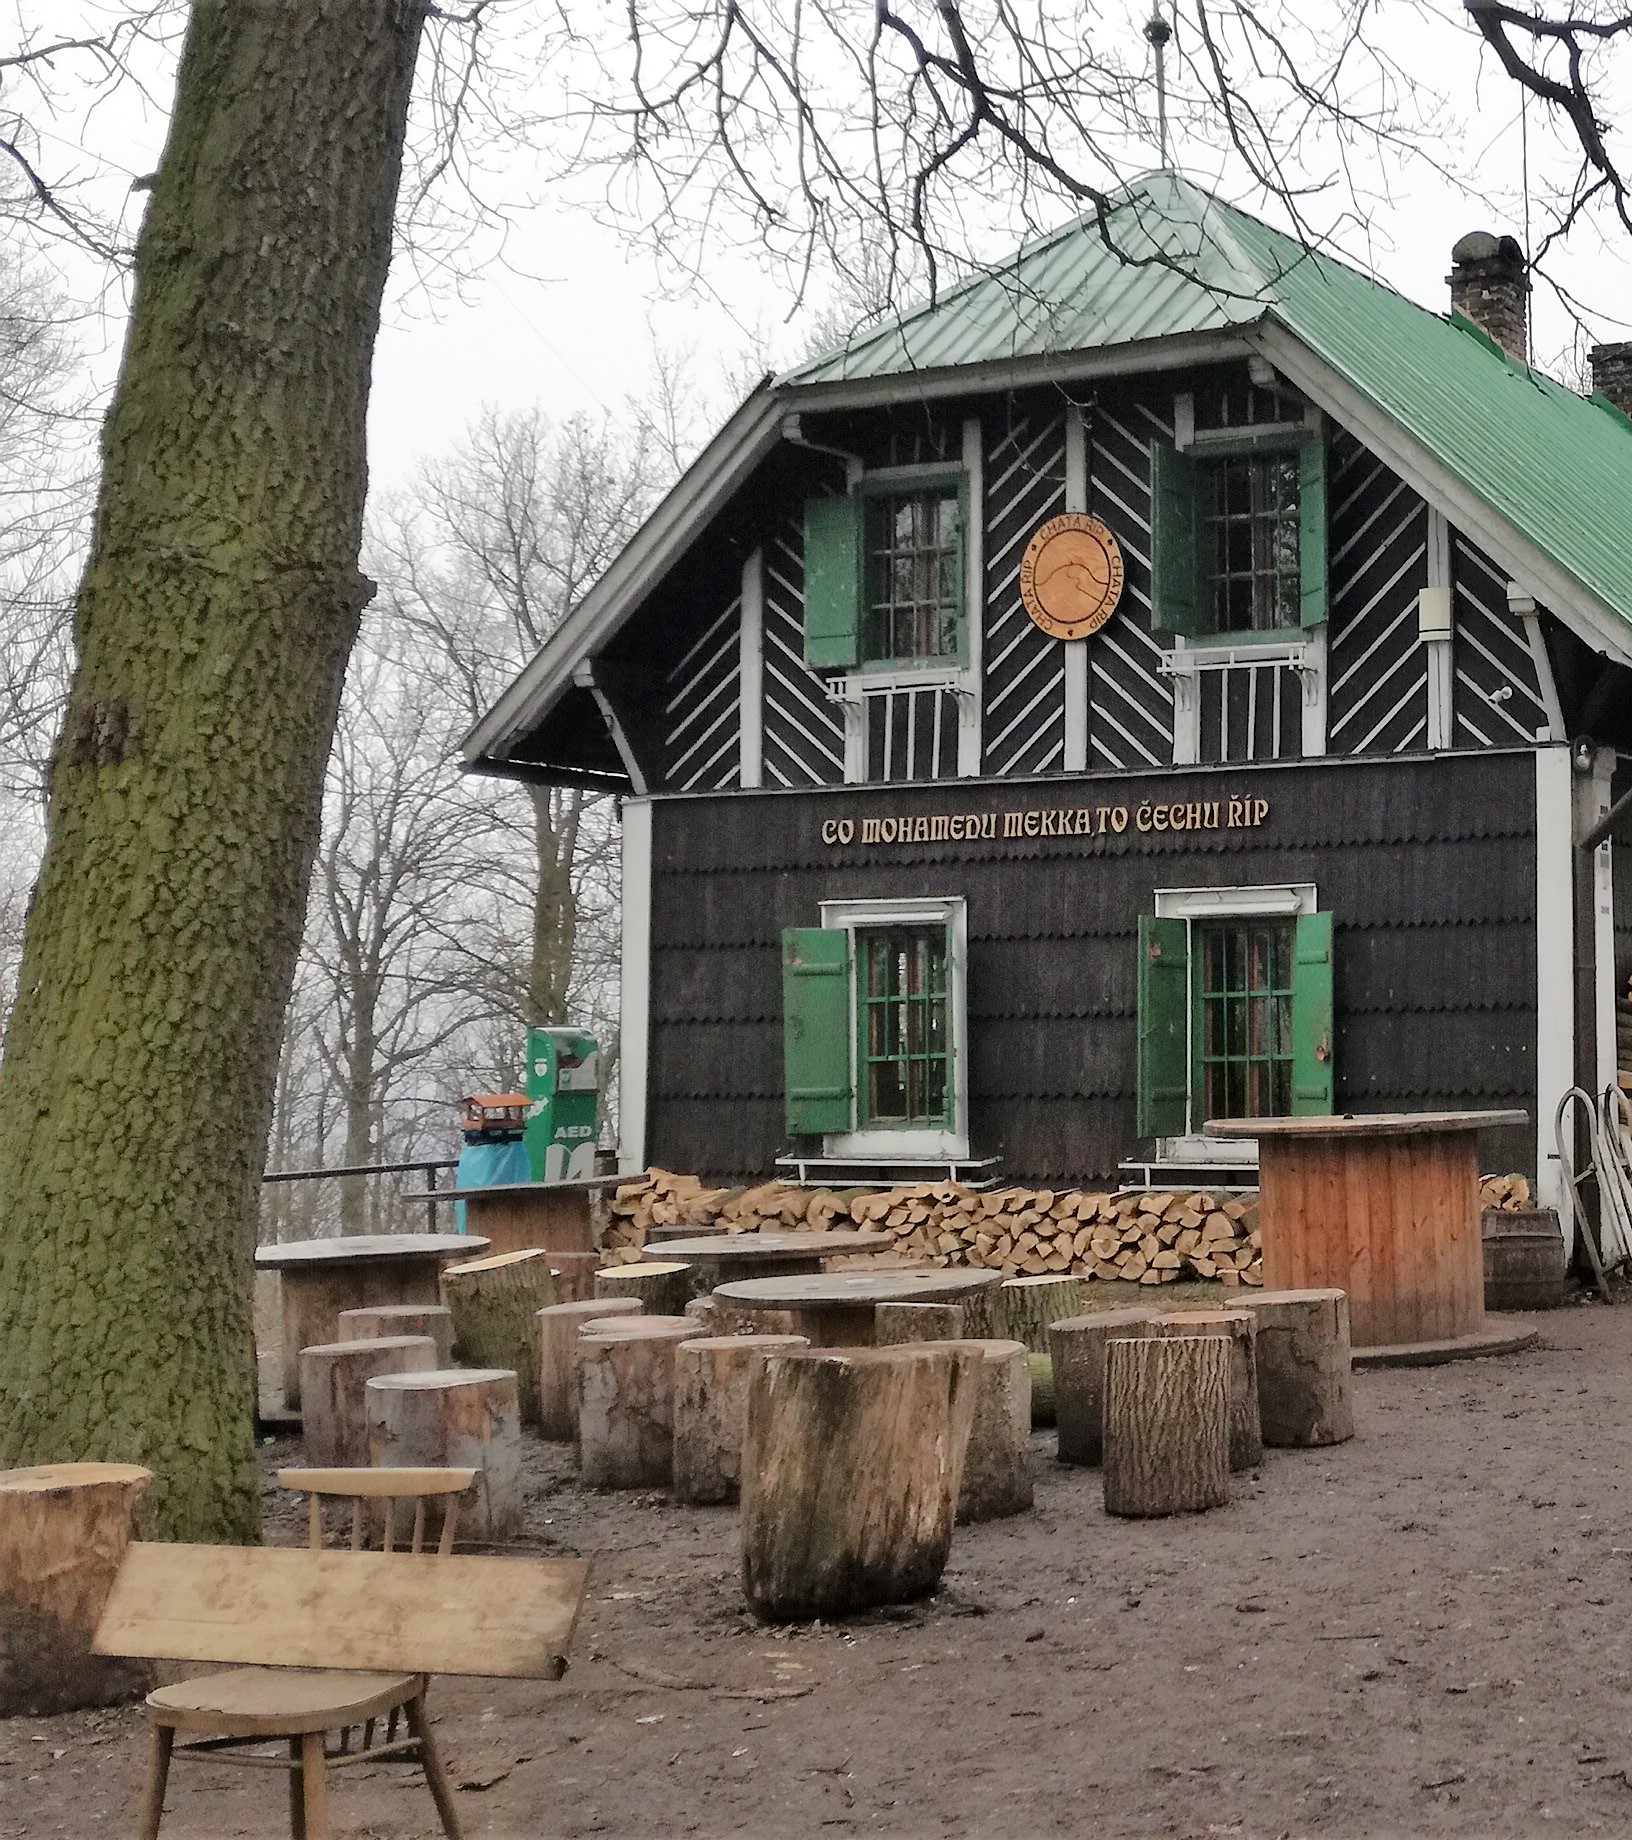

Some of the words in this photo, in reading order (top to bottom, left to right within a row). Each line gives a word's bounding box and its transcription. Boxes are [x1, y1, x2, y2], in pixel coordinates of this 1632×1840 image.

[1040, 516, 1081, 540] CHATA
[1105, 555, 1123, 607] CHATA
[1024, 587, 1053, 630] CHATA
[821, 819, 855, 844] CO
[861, 813, 998, 843] MOHAMEDU
[1096, 807, 1128, 833] TO
[1136, 800, 1220, 832] ČECHU
[1227, 794, 1269, 827] ŘÍP
[554, 1125, 592, 1139] AED
